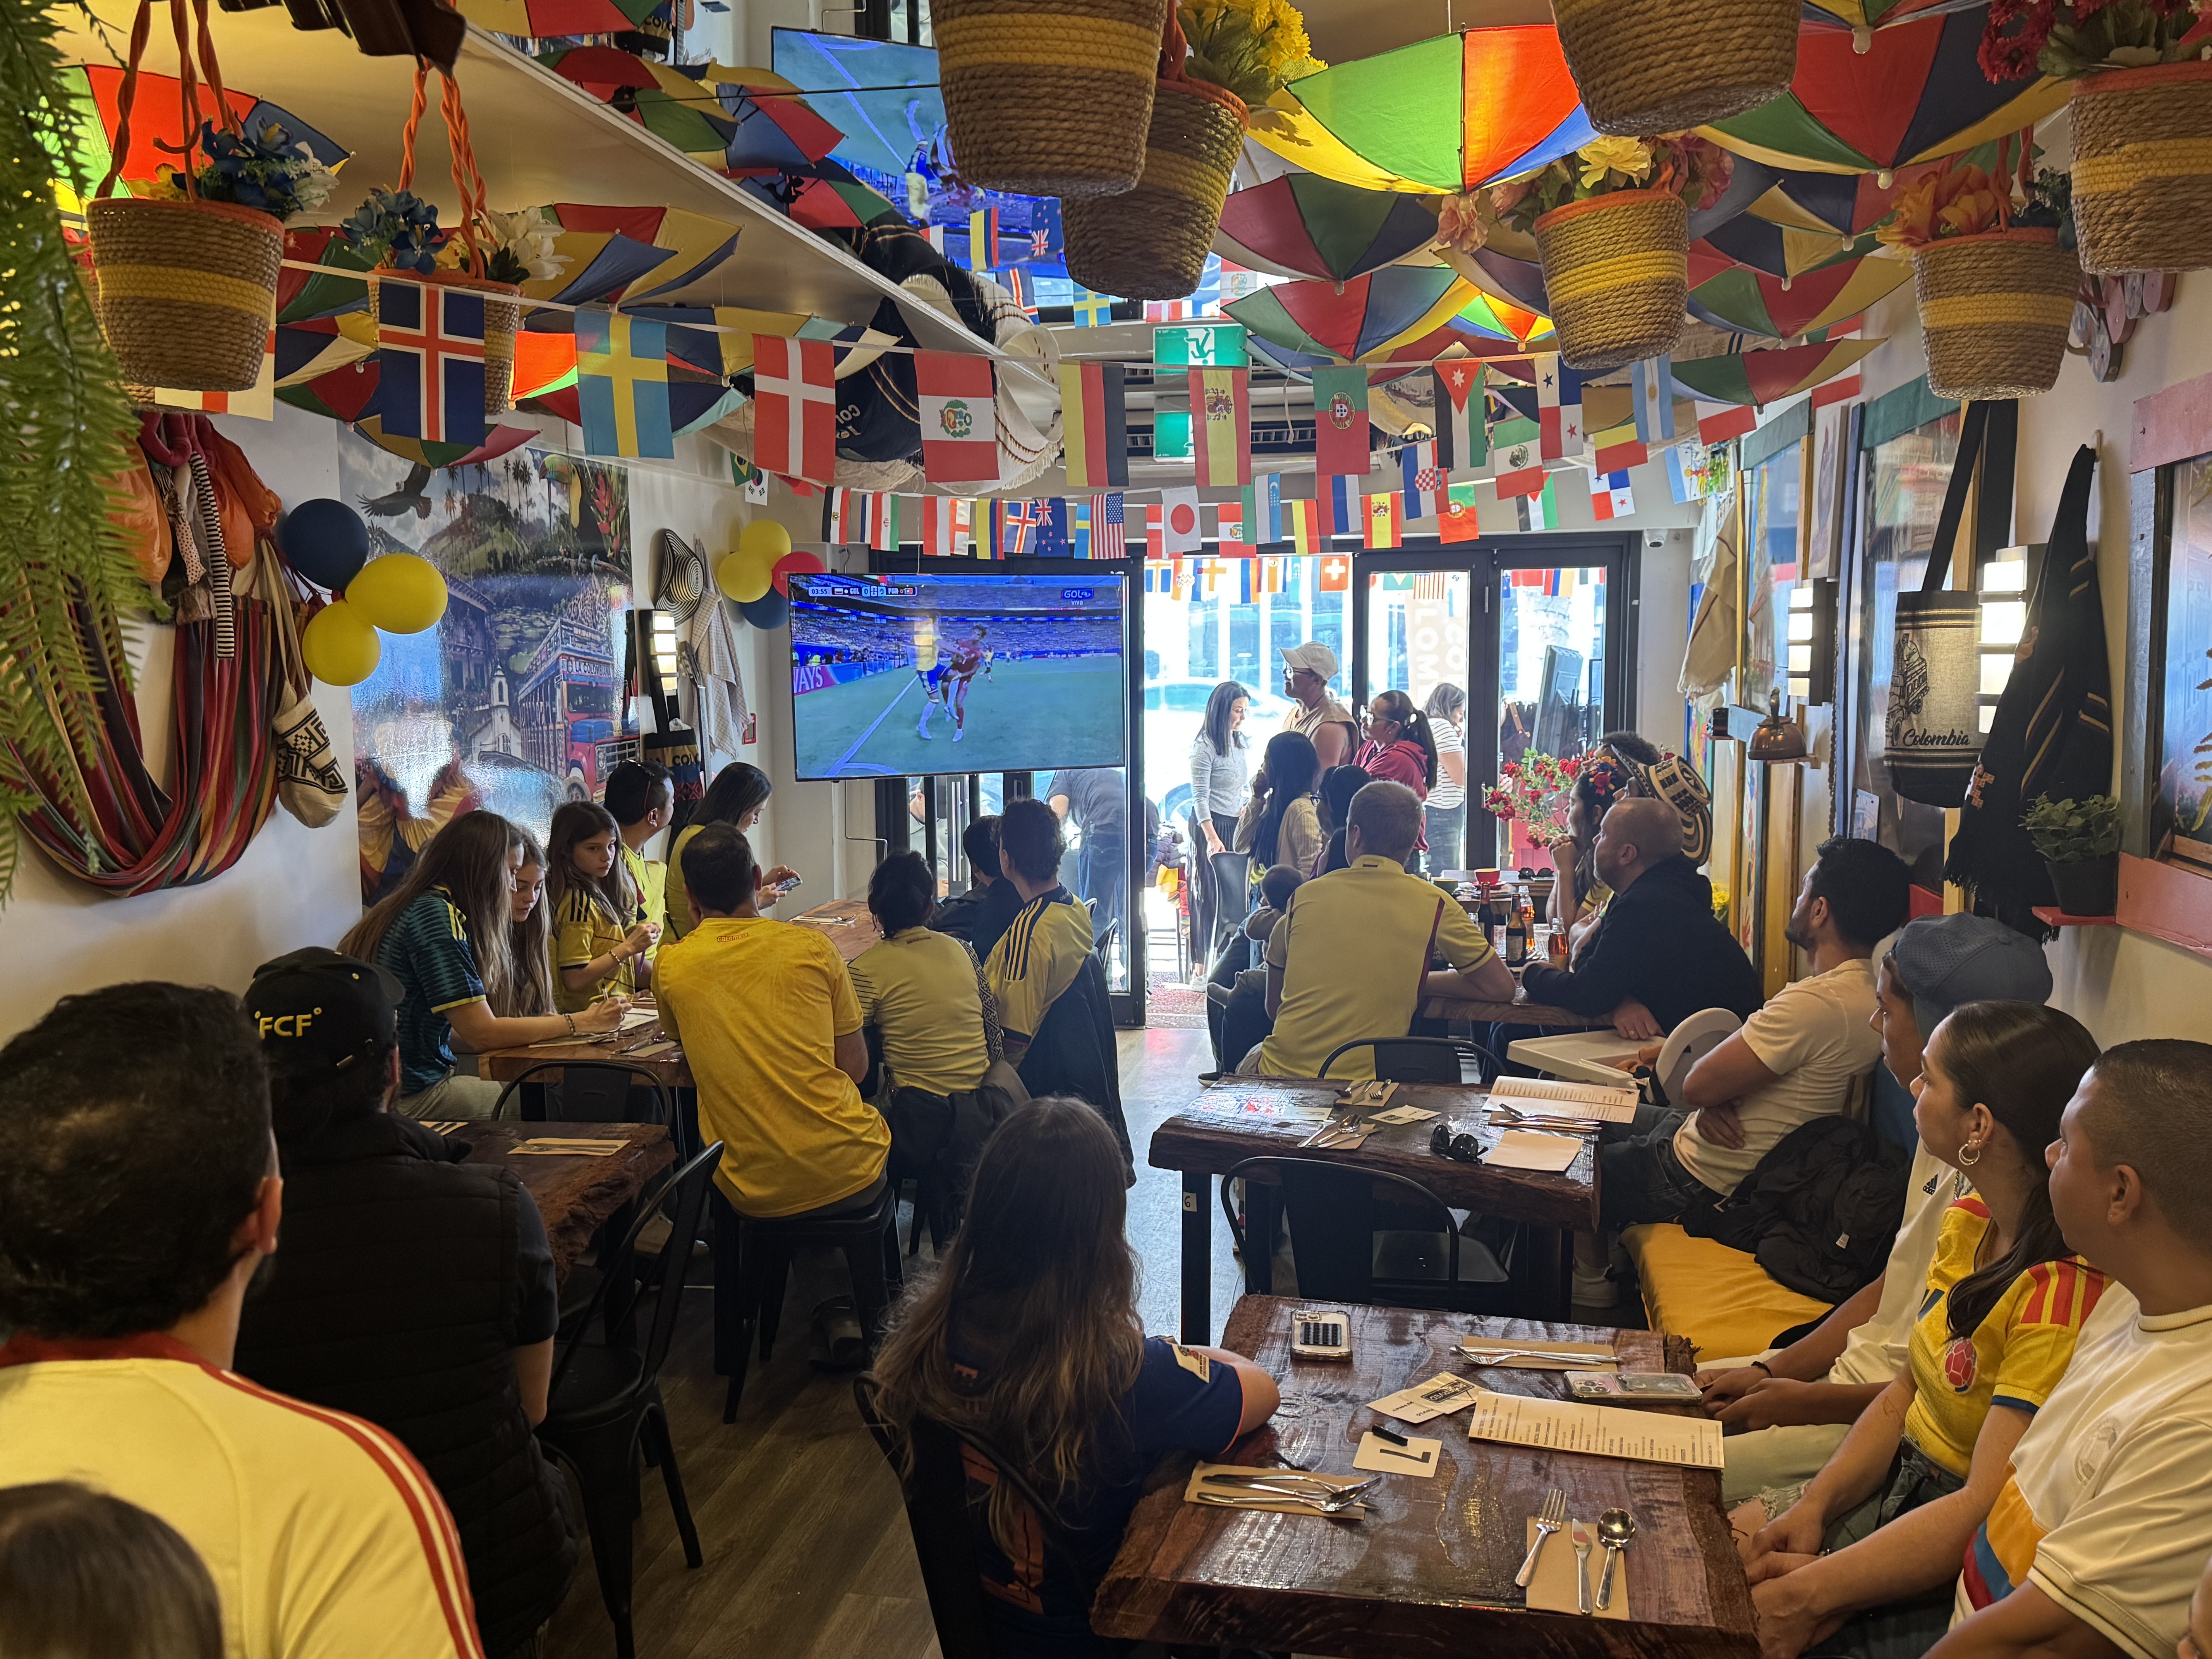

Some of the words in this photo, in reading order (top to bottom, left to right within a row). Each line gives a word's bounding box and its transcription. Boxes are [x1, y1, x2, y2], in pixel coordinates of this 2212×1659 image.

[1903, 728, 1970, 746] Colombia
[259, 1014, 312, 1039] FCF
[1184, 1196, 1190, 1207] 6
